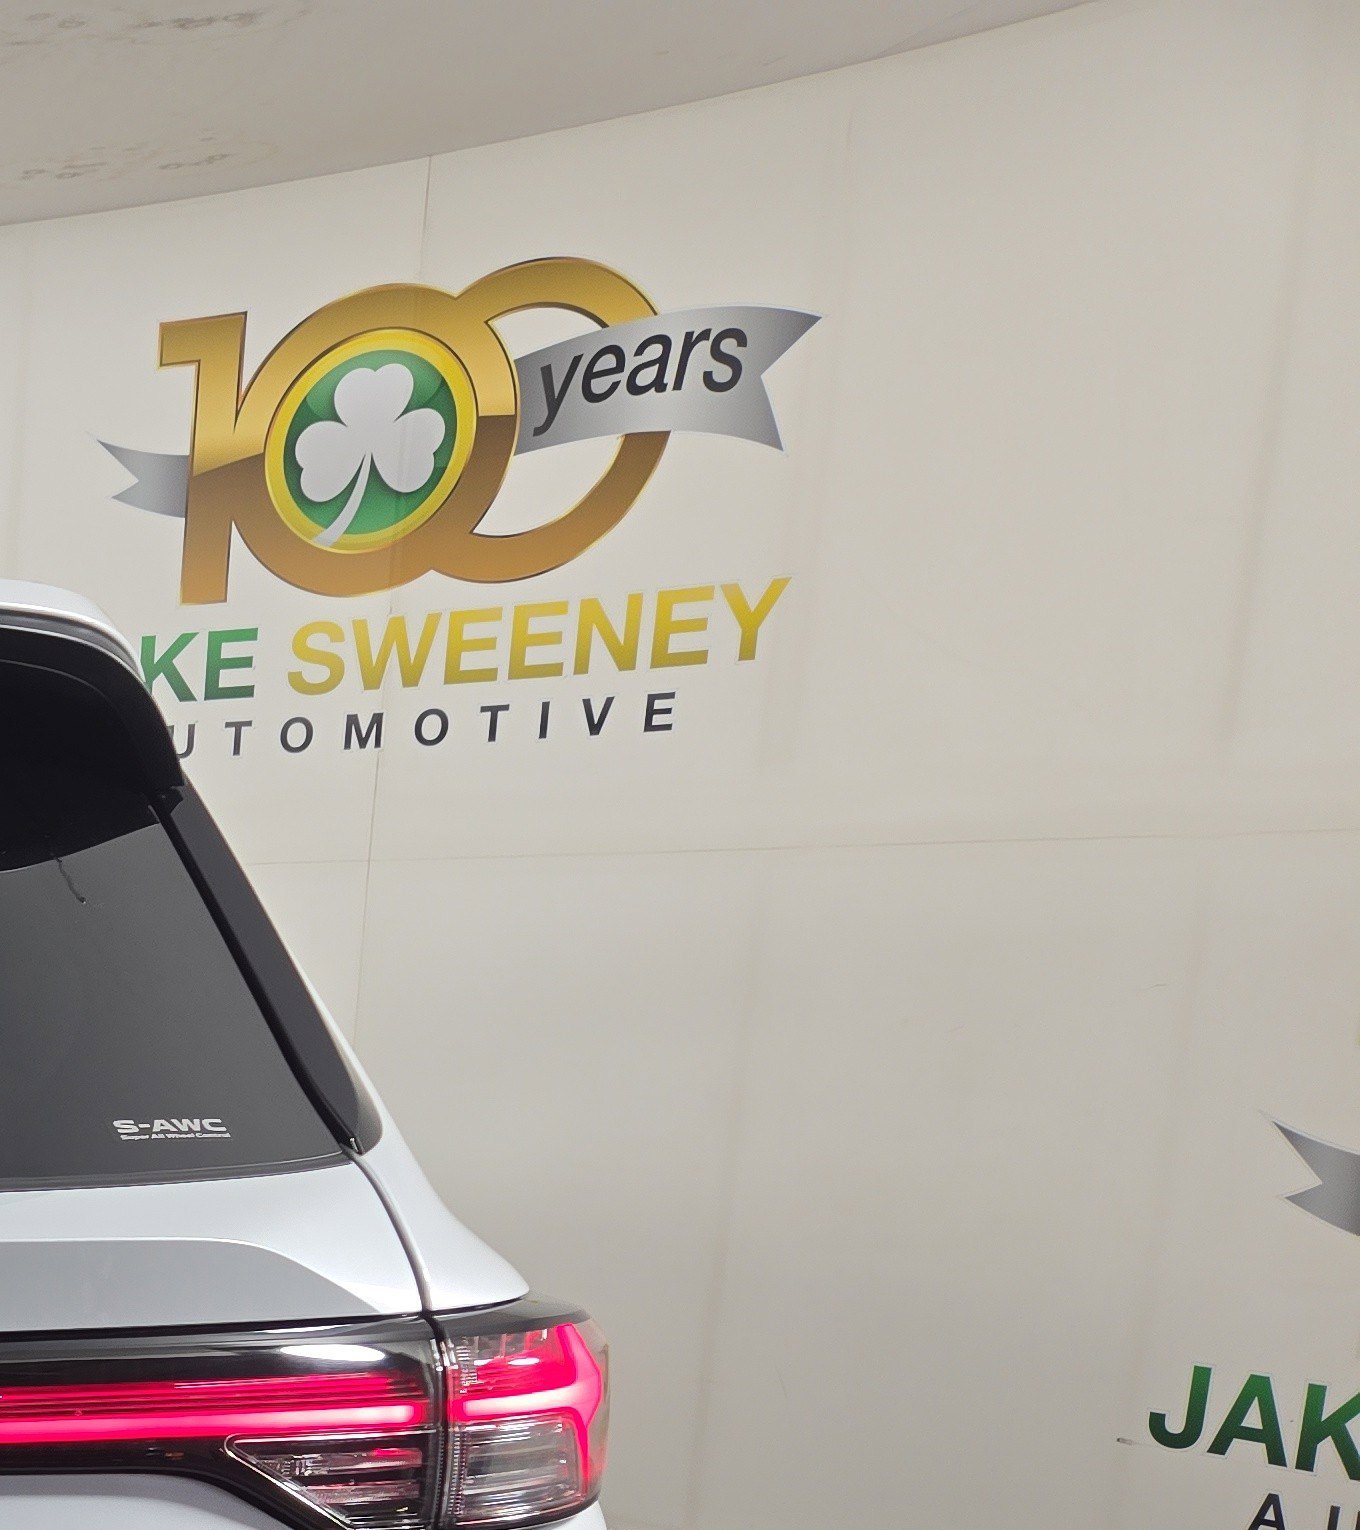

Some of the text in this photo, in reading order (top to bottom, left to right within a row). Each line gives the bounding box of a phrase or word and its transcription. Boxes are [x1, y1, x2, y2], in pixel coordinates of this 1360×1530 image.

[156, 257, 671, 606] 100
[532, 326, 748, 437] years
[287, 576, 792, 698] SWEENEY
[113, 1118, 227, 1133] S-AWC
